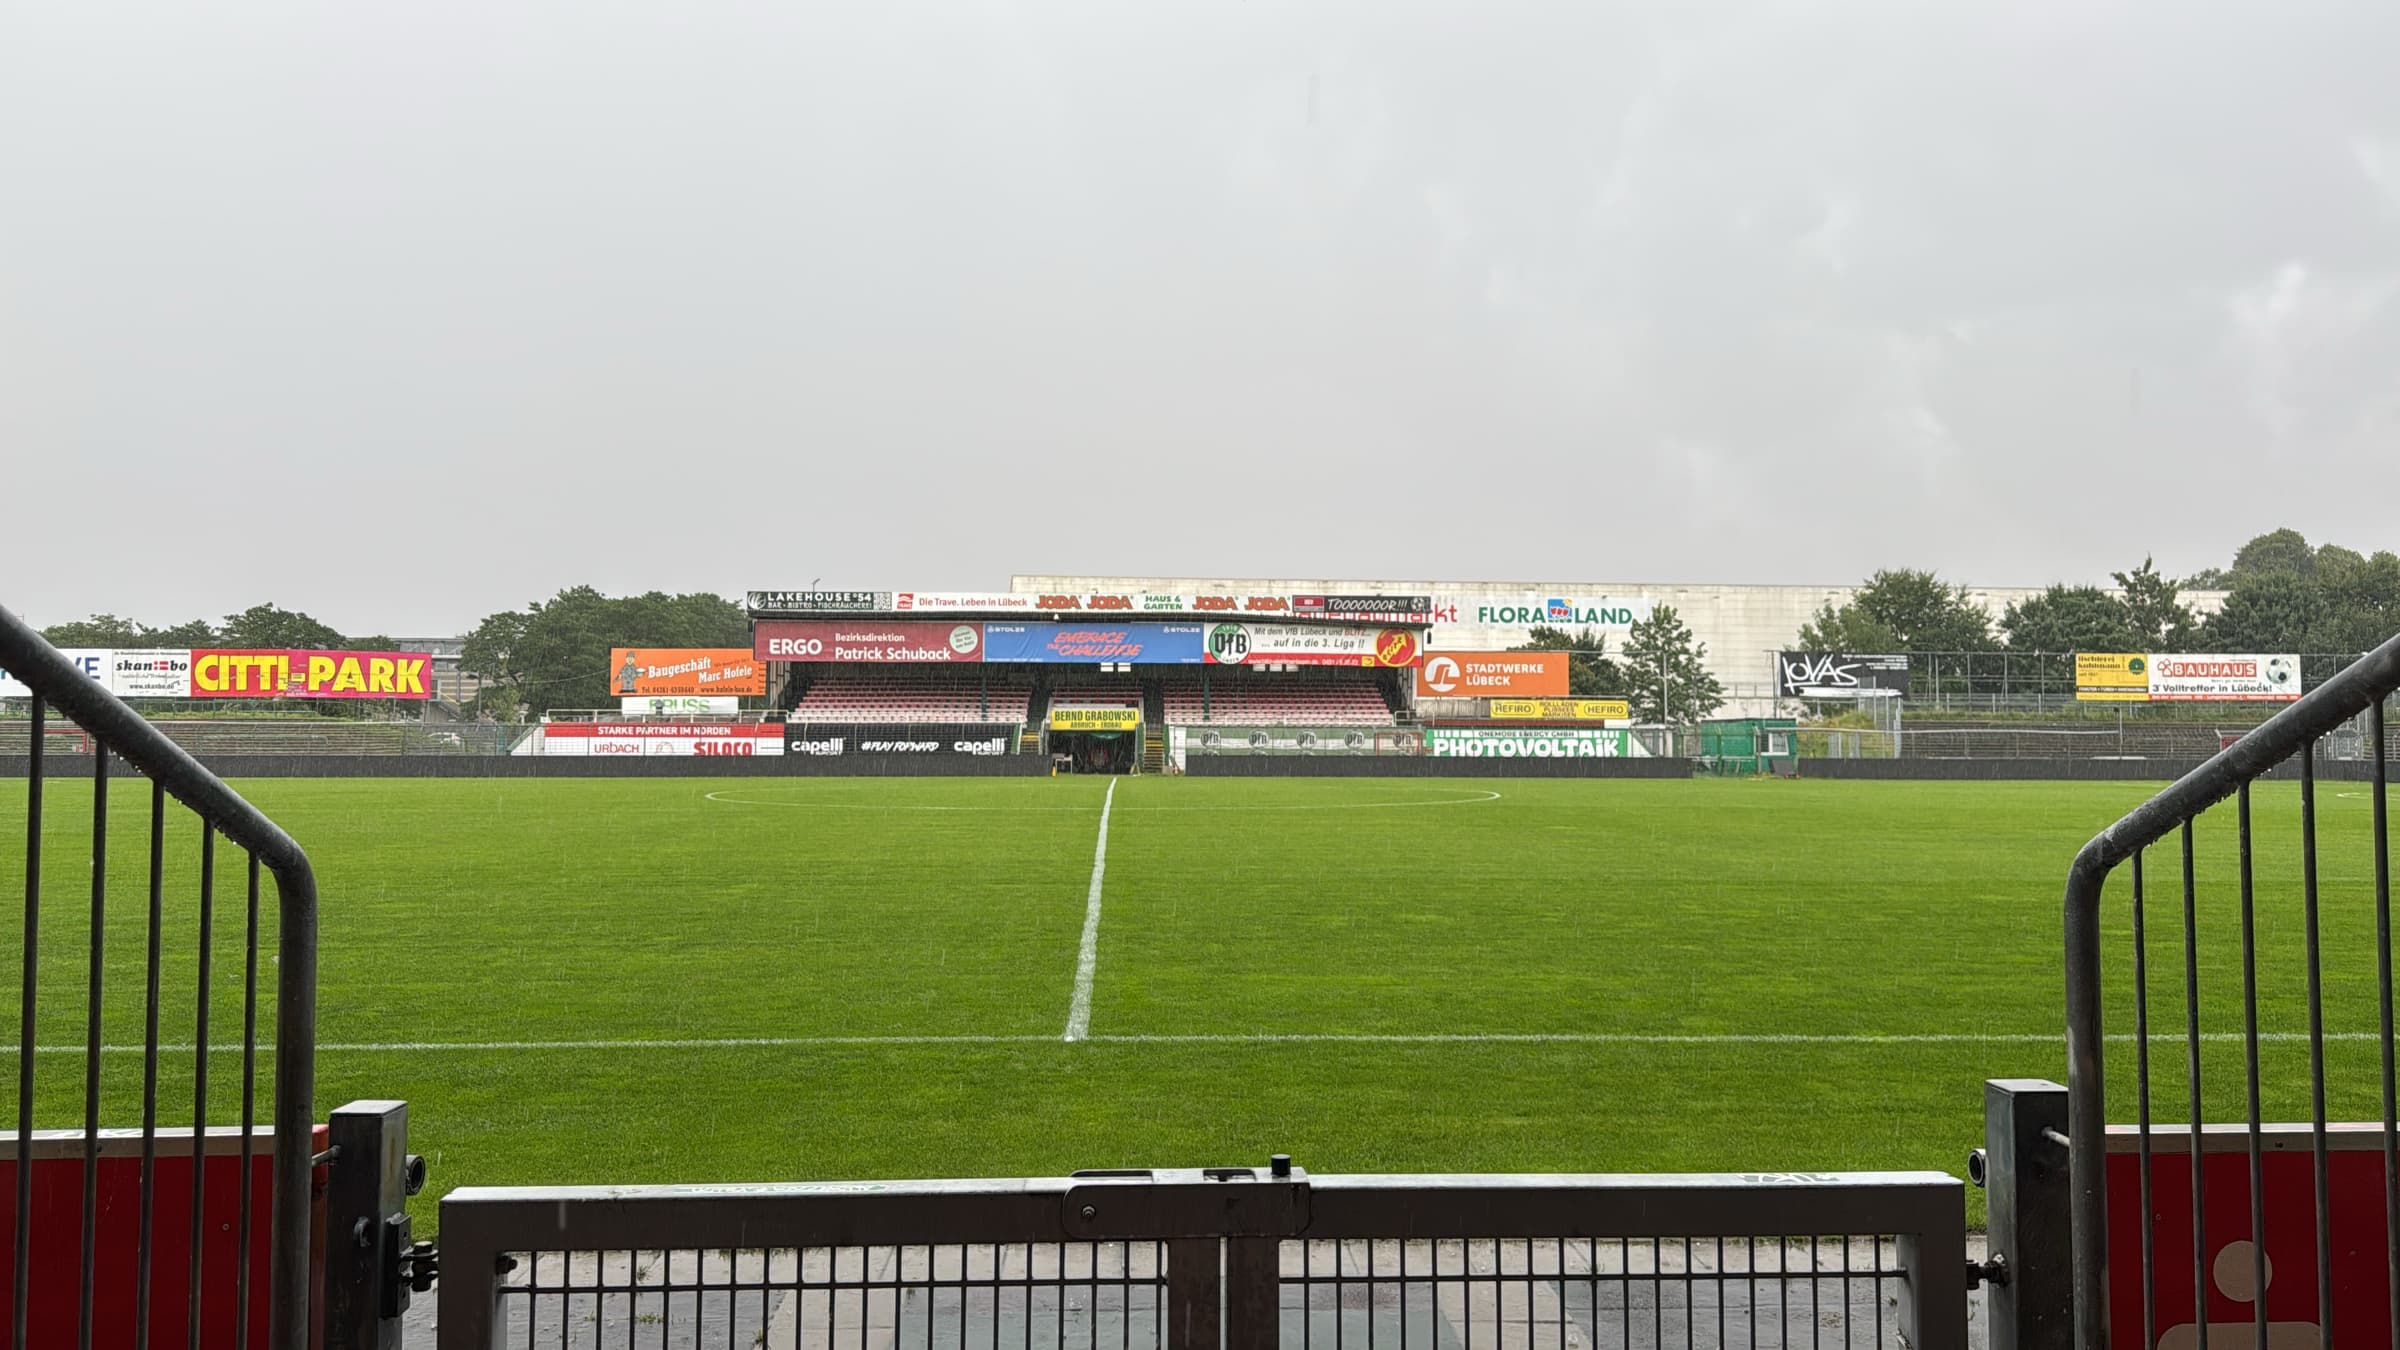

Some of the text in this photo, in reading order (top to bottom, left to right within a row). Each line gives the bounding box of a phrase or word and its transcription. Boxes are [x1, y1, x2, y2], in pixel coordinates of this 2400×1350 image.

[768, 593, 850, 601] LAKEHOUSE
[919, 598, 1027, 607] Die Trave. Leben in Lübeck
[1036, 595, 1081, 609] JODA
[1087, 596, 1133, 609] JODA
[1192, 596, 1238, 610] JODA
[1244, 597, 1290, 611] JODA
[1478, 606, 1633, 625] FLORA LAND
[835, 633, 905, 642] Bezirksdirektion
[1254, 628, 1265, 636] Mit
[1267, 628, 1283, 636] dem
[1285, 628, 1298, 636] VfB
[1300, 628, 1327, 636] Lübeck
[1328, 628, 1343, 636] und
[769, 638, 822, 655] ERGO
[1273, 639, 1288, 648] auf
[1291, 640, 1300, 648] in
[1304, 639, 1318, 648] die
[1322, 640, 1331, 648] 3.
[1334, 640, 1354, 649] Liga
[835, 647, 951, 660] Patrick Schuback
[648, 656, 711, 679] Baugeschäft
[1466, 663, 1544, 674] STADTWERKE
[2173, 663, 2257, 677] BAUHAUS
[698, 671, 721, 684] Marc
[723, 665, 752, 680] Hofele
[1466, 674, 1511, 686] LÜBECK
[2163, 684, 2215, 692] Volltreffer
[1495, 704, 1531, 713] HEFIRO
[1587, 706, 1624, 714] HEFIRO
[1054, 710, 1136, 721] BERND GRABOWSKI
[598, 727, 731, 735] STARKE PARTNER IM NORDEN
[791, 738, 843, 755] capelli
[954, 738, 1005, 755] capelli
